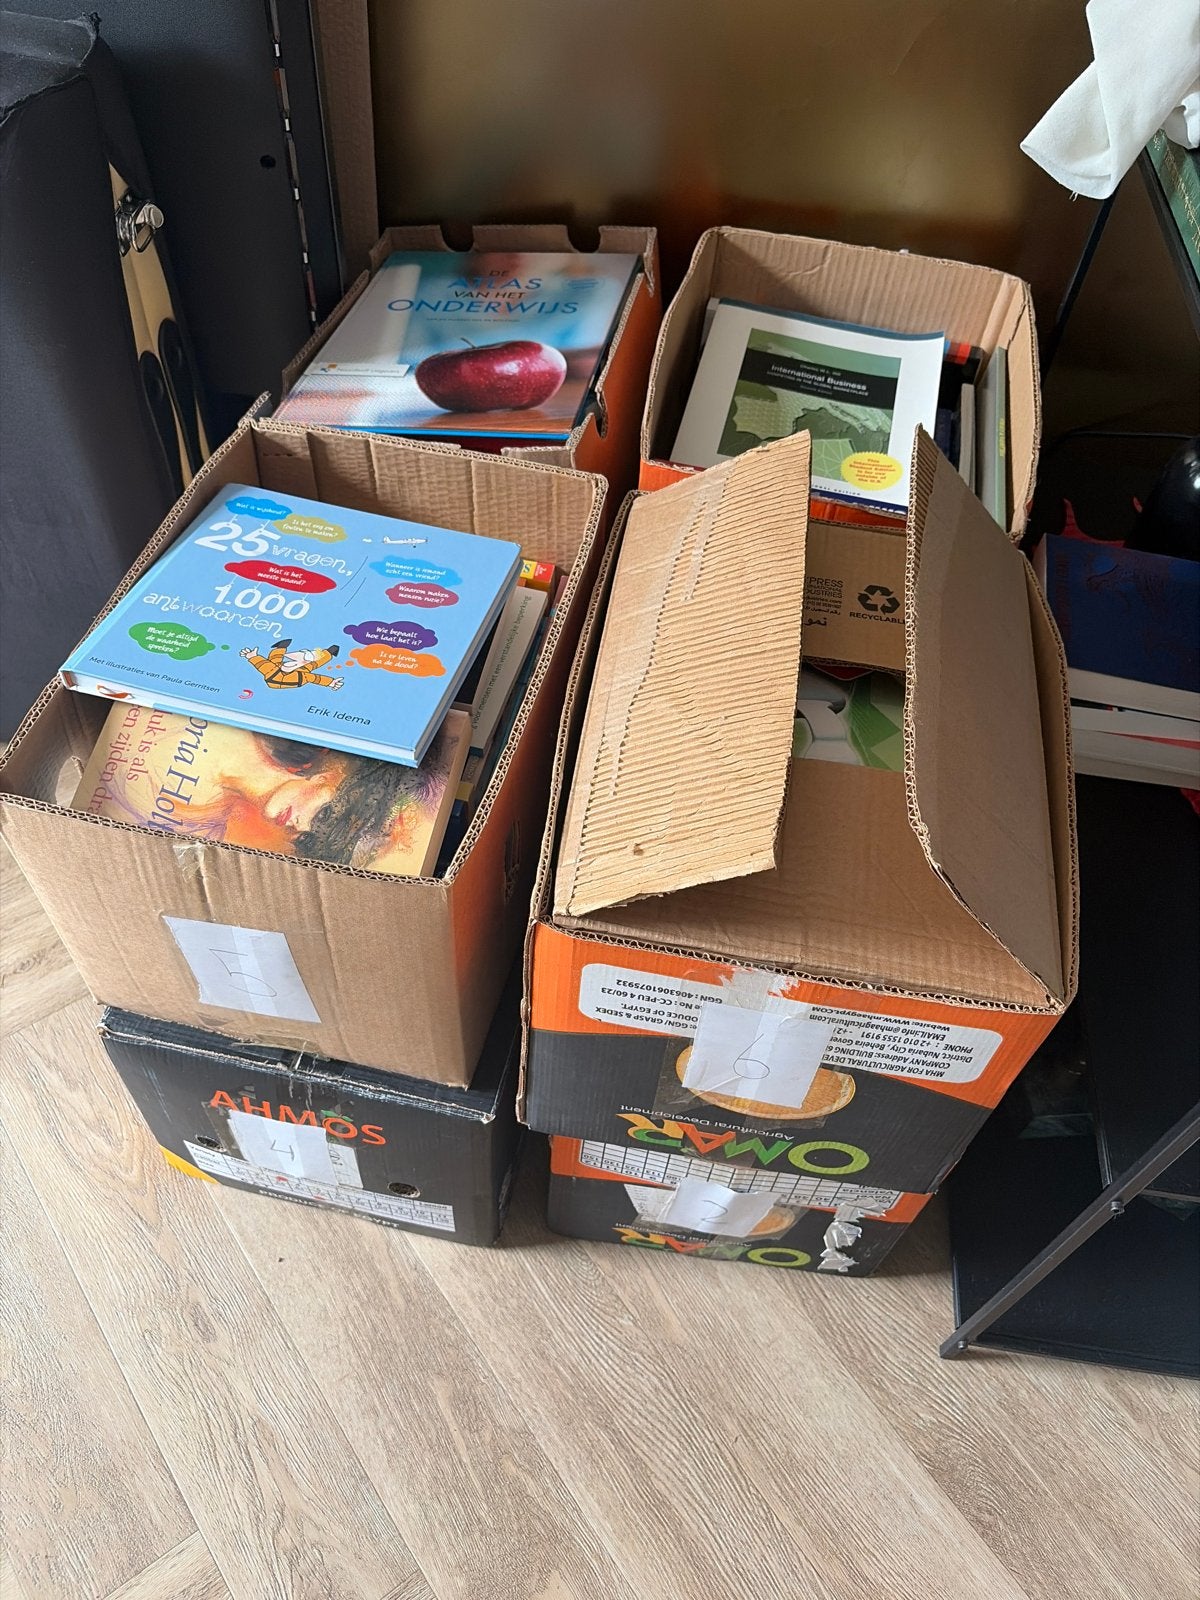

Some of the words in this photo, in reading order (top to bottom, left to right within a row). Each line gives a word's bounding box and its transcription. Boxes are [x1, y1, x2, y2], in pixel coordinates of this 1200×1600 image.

[488, 269, 510, 277] DE
[447, 277, 543, 290] ATLAS
[454, 290, 489, 299] VAN
[494, 291, 526, 299] HET
[387, 299, 580, 314] ONDERWIJS
[771, 364, 825, 382] International
[826, 377, 867, 391] Business
[299, 519, 311, 528] het
[282, 523, 303, 533] fouten
[312, 529, 339, 538] maken?
[194, 520, 282, 557] 25
[271, 543, 353, 577] vragen,
[268, 566, 283, 575] Wat
[290, 570, 303, 579] het
[385, 561, 414, 571] Wanneer
[422, 567, 446, 576] iemand
[257, 571, 280, 582] meeste
[280, 574, 307, 586] waard?
[415, 572, 440, 581] vriend?
[398, 585, 426, 595] Waarom
[427, 591, 450, 599] maken
[398, 593, 424, 601] mensen
[424, 596, 444, 604] ruzie?
[213, 584, 310, 620] 1.000
[143, 592, 283, 639] antwoorden
[146, 626, 166, 636] Moet
[166, 630, 176, 638] je
[176, 632, 199, 642] altijd
[380, 633, 397, 642] laat
[398, 636, 410, 644] het
[389, 628, 418, 639] bepaalt
[145, 634, 156, 642] de
[157, 636, 191, 649] waarheid
[394, 659, 419, 669] dood?
[398, 653, 417, 662] leven
[88, 655, 103, 666] Met
[104, 659, 145, 676] illustraties
[145, 670, 161, 679] van
[161, 672, 183, 685] Paula
[183, 678, 221, 693] Gerritsen
[477, 685, 493, 711] mensen
[306, 704, 331, 717] Erik
[332, 709, 372, 726] Idema
[138, 740, 158, 754] is
[100, 731, 132, 783] zijden
[126, 756, 149, 781] als
[209, 947, 278, 999] 5
[600, 987, 628, 998] 60/23
[615, 979, 694, 999] 4063061075932
[637, 993, 673, 1006] CC-PEU
[679, 1002, 693, 1010] No
[699, 994, 723, 1005] GGN
[594, 1006, 624, 1018] SEDEX
[620, 1003, 652, 1015] EGYPT.
[652, 1009, 666, 1017] OF
[633, 1013, 664, 1025] GRASP
[665, 1010, 699, 1023] ODUCE
[664, 1019, 689, 1029] GGN/
[910, 1020, 951, 1032] Website:
[860, 1031, 882, 1040] 9191
[882, 1033, 903, 1043] 1555
[903, 1037, 920, 1046] 010
[854, 1040, 886, 1050] Beheira
[920, 1039, 932, 1047] +2
[943, 1043, 974, 1054] PHONE
[732, 1032, 771, 1080] 6
[833, 1046, 875, 1058] BUILDING
[874, 1051, 910, 1064] Address:
[907, 1047, 941, 1059] Nubaria
[942, 1051, 974, 1064] District,
[847, 1057, 908, 1072] AGRICULTURAL
[909, 1057, 951, 1069] COMPANY
[907, 1067, 924, 1076] FOR
[924, 1068, 946, 1078] MHA
[209, 1089, 387, 1146] AHMOS
[619, 1103, 710, 1128] Development
[714, 1121, 796, 1141] Agricultural
[271, 1138, 296, 1162] 4
[616, 1113, 871, 1175] OMAR
[611, 1227, 812, 1268] OMAR
